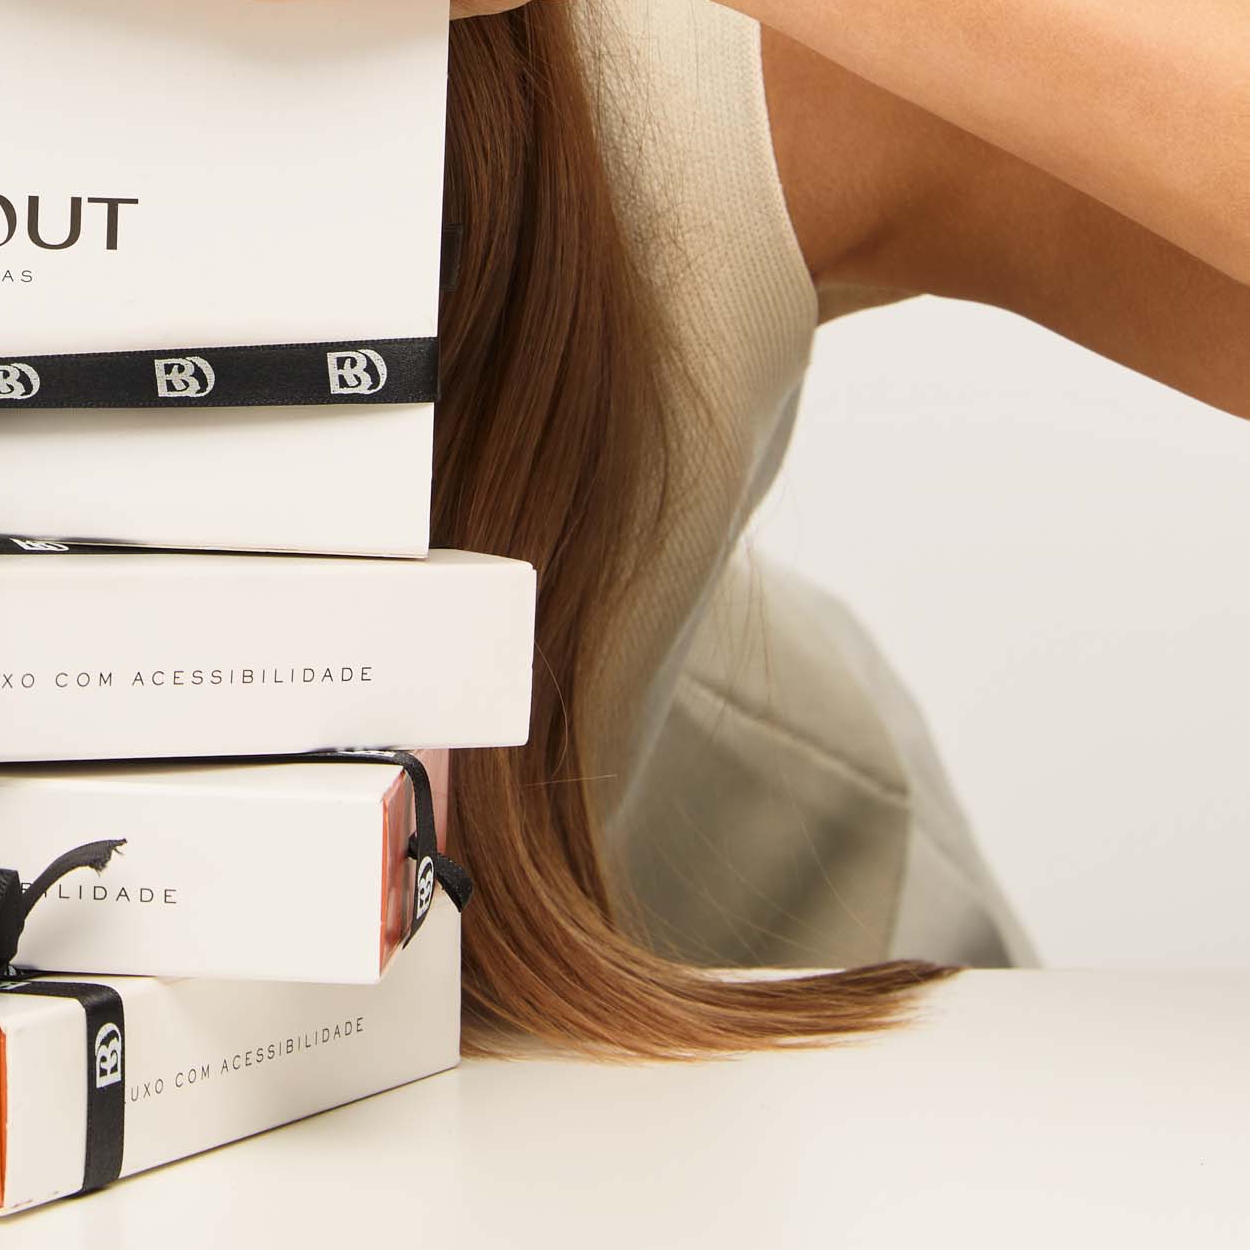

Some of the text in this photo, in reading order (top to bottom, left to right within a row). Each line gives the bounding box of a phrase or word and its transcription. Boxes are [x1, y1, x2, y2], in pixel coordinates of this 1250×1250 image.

[54, 671, 114, 688] COM
[131, 666, 374, 687] ACESSIBILIDADE
[125, 1016, 365, 1104] UXO COM ACESSIBILIDADE
